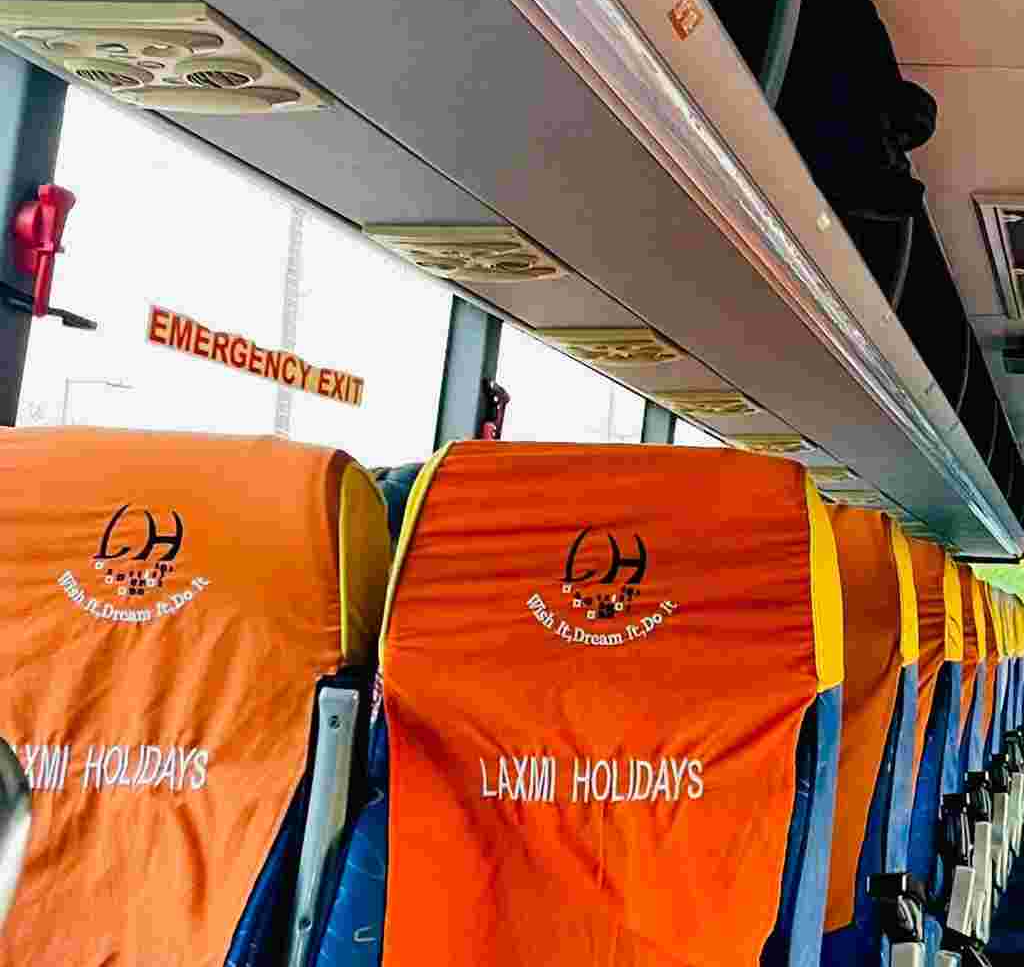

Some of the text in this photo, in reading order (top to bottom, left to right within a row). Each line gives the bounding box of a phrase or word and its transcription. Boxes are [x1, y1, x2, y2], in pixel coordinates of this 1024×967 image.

[150, 308, 364, 405] EMERGENCY EXIT
[526, 593, 554, 628] Wish
[23, 744, 209, 792] XMI HOLIDAYS
[479, 754, 704, 802] LAXMI HOLIDAYS
